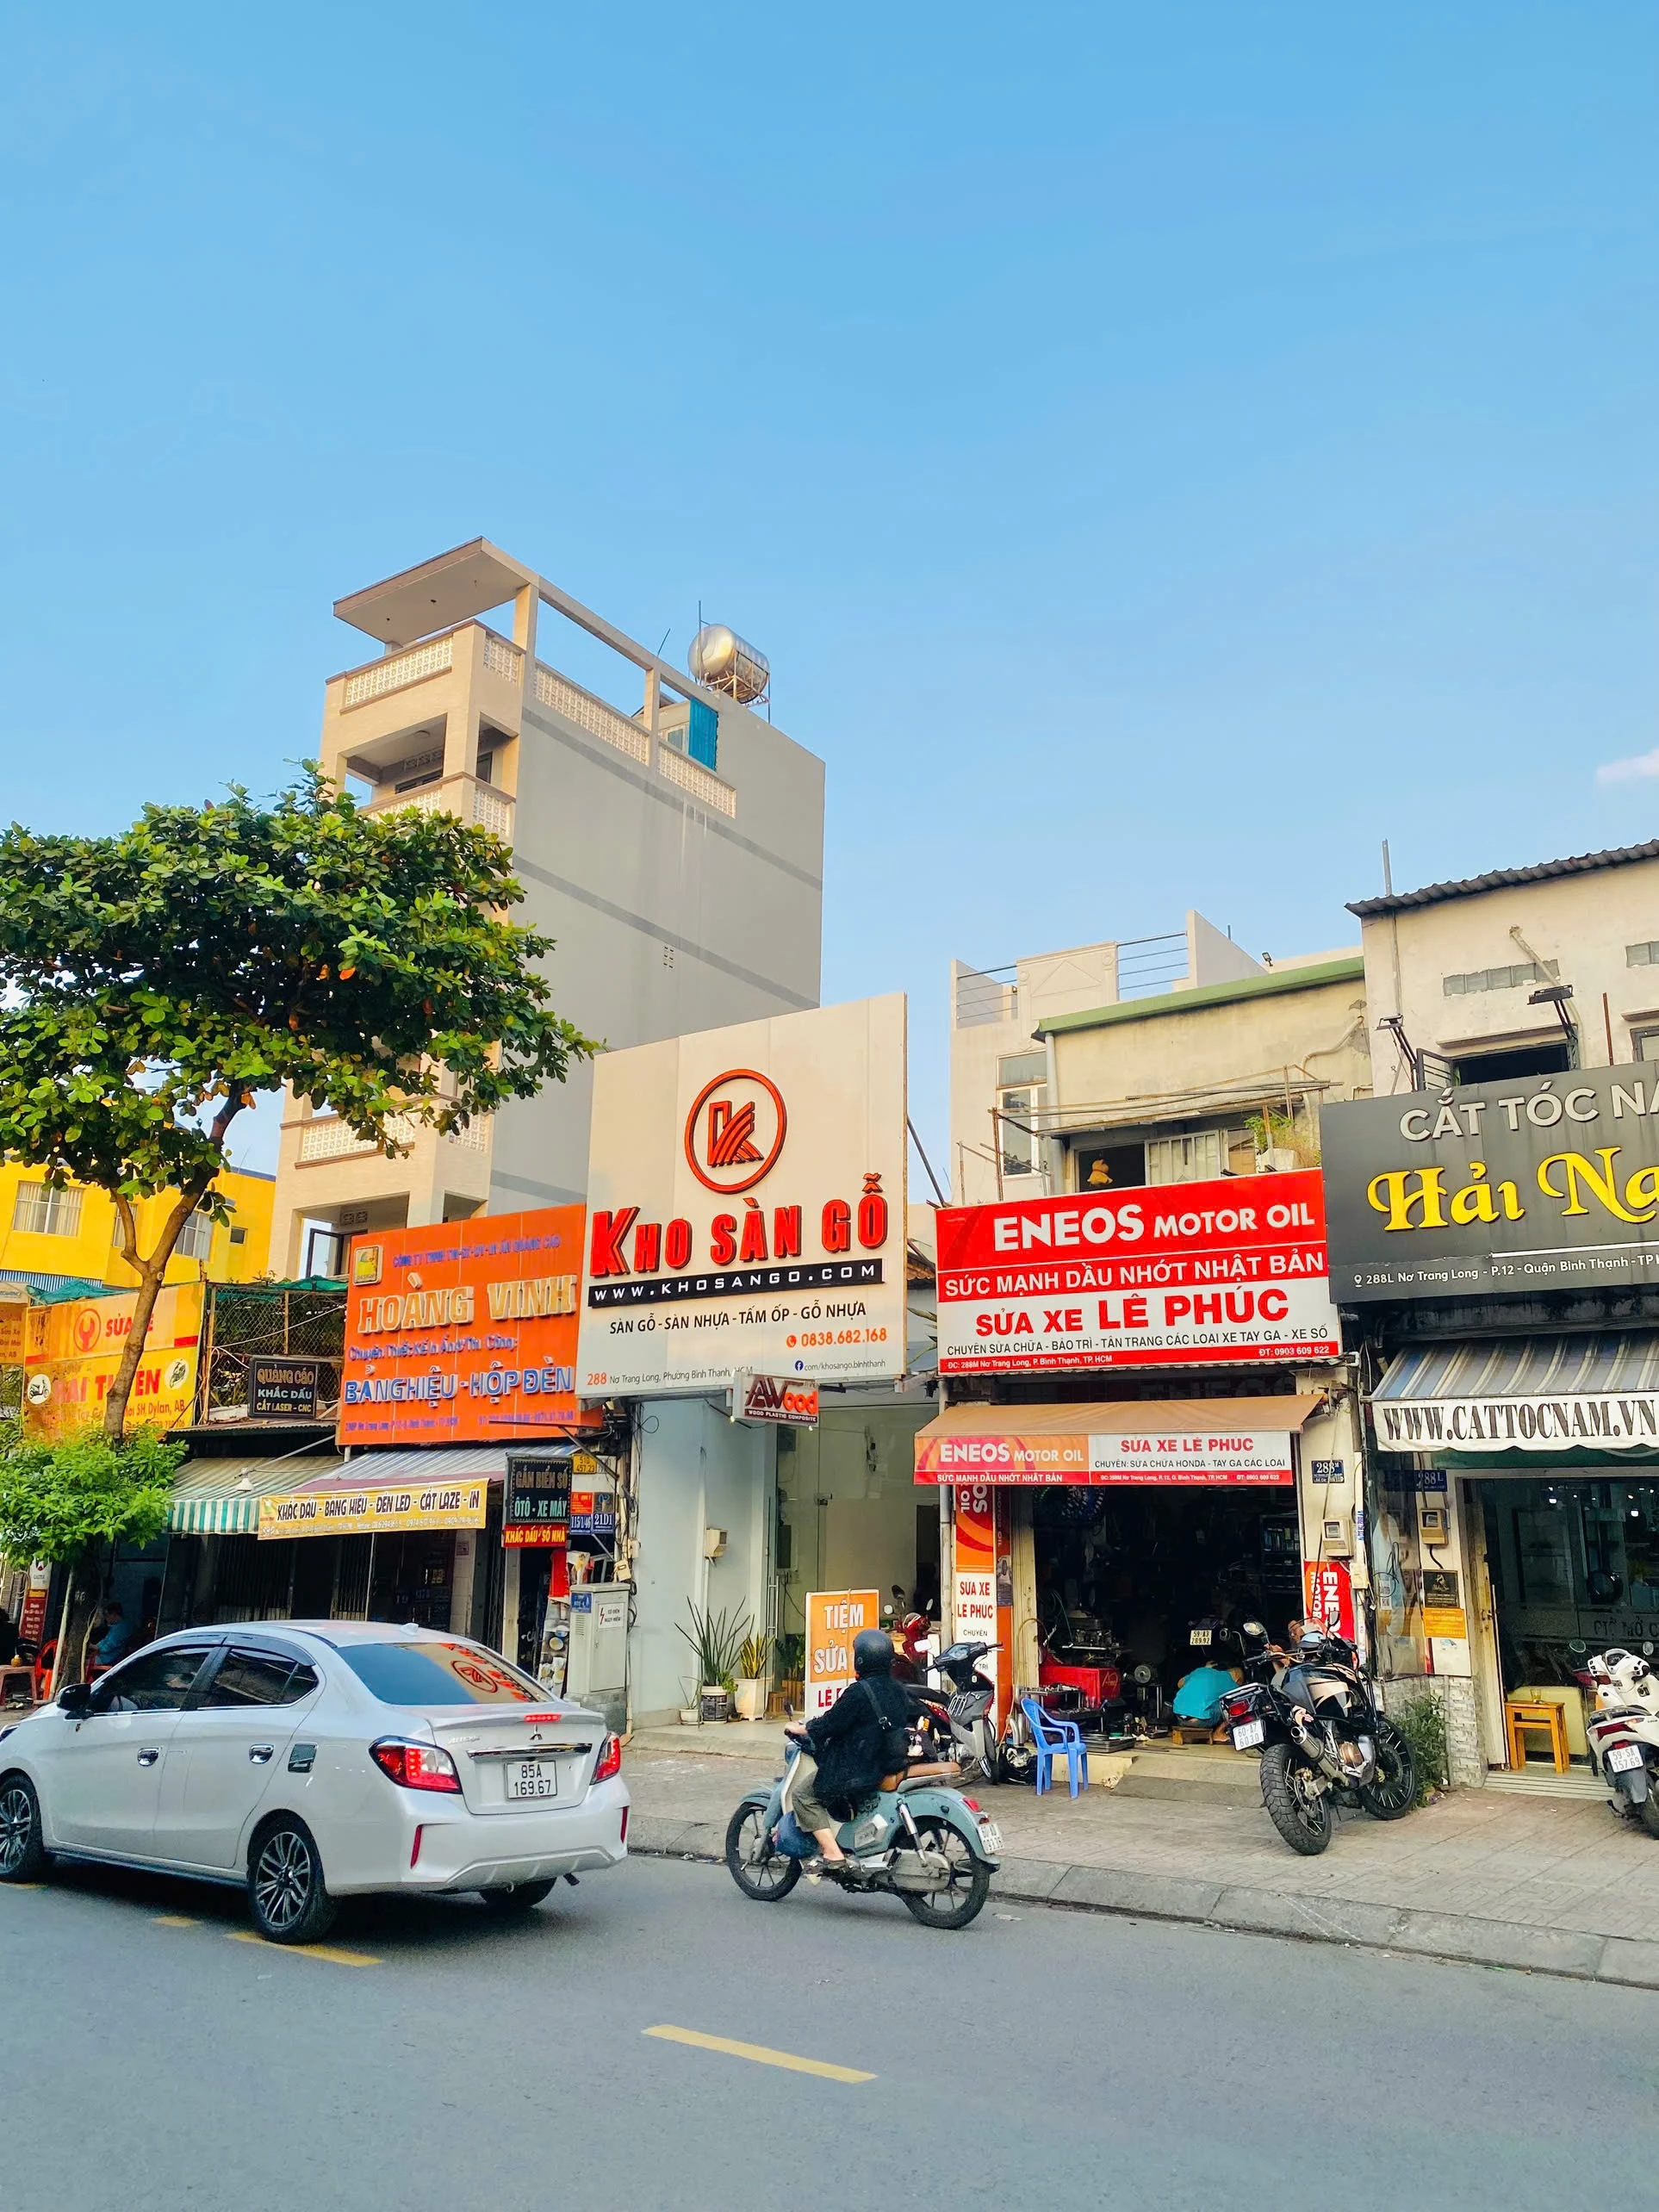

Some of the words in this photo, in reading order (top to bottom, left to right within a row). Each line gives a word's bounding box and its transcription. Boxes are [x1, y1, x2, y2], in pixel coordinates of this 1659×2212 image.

[1400, 1087, 1485, 1141] CẮT
[1499, 1081, 1600, 1130] TÓC
[1367, 1160, 1525, 1232] Hải
[711, 1197, 802, 1266] SÀN
[821, 1172, 888, 1252] GỖ
[994, 1204, 1145, 1252] ENEOS
[1153, 1208, 1258, 1238] MOTOR
[1267, 1202, 1315, 1228] OIL
[945, 1275, 991, 1296] SỨC
[997, 1271, 1059, 1296] MẠNH
[1066, 1263, 1112, 1288] DẦU
[1120, 1258, 1187, 1283] NHỚT
[1195, 1254, 1261, 1282] NHẬT
[1269, 1248, 1324, 1274] BẢN
[1366, 1274, 1394, 1285] 288L
[1398, 1271, 1414, 1283] Nơ
[1417, 1271, 1448, 1283] Trang
[1451, 1269, 1479, 1281] Long
[1491, 1265, 1514, 1276] P.12
[1524, 1262, 1556, 1277] Quận
[1560, 1258, 1586, 1271] Bình
[1589, 1258, 1629, 1272] Thạnh
[357, 1271, 474, 1333] HOÀNG
[487, 1275, 577, 1320] VINH
[976, 1308, 1034, 1337] SỬA
[1043, 1308, 1083, 1333] XE
[1098, 1293, 1149, 1330] LÊ
[1165, 1285, 1289, 1327] PHÚC
[610, 1318, 633, 1334] SÀN
[637, 1312, 656, 1332] GỖ
[664, 1314, 689, 1331] SÀN
[693, 1311, 730, 1330] NHỰA
[739, 1305, 767, 1324] TẤM
[771, 1303, 790, 1321] ỐP
[801, 1301, 821, 1320] GỖ
[826, 1302, 867, 1321] NHỰA
[801, 1328, 887, 1347] 0838.682.168
[948, 1342, 986, 1356] CHUYÊN
[1013, 1339, 1043, 1352] CHỮA
[1052, 1339, 1073, 1351] BẢO
[1076, 1337, 1092, 1350] TRÌ
[1101, 1335, 1122, 1349] TÂN
[1125, 1336, 1163, 1348] TRANG
[1165, 1333, 1190, 1345] CÁC
[1193, 1333, 1219, 1346] LOẠI
[1222, 1332, 1237, 1343] XE
[1240, 1331, 1260, 1342] TAY
[1264, 1330, 1281, 1341] GA
[1291, 1328, 1307, 1339] XE
[1310, 1323, 1328, 1339] SỐ
[1259, 1348, 1273, 1357] ĐT:
[1274, 1347, 1295, 1356] 0903
[1296, 1346, 1312, 1355] 609
[1314, 1345, 1329, 1354] 622
[991, 1359, 1010, 1369] Trang
[1012, 1358, 1032, 1368] Long,
[1040, 1356, 1055, 1364] Bình
[1057, 1356, 1081, 1365] Thạnh,
[1094, 1355, 1113, 1364] HCM
[257, 1364, 293, 1384] QUẢNG
[295, 1367, 314, 1385] CÁO
[470, 1361, 519, 1404] HỘP
[522, 1356, 575, 1394] ĐÈN
[587, 1372, 607, 1385] 288
[610, 1375, 619, 1384] Nơ
[622, 1374, 640, 1385] Trang
[643, 1373, 662, 1384] Long,
[663, 1370, 689, 1383] Phường
[692, 1369, 706, 1380] Bình
[258, 1386, 289, 1398] KHẮC
[290, 1387, 312, 1399] DẤU
[148, 1401, 172, 1420] Dylan,
[175, 1399, 185, 1412] AB
[257, 1398, 271, 1411] CẮT
[272, 1403, 292, 1412] LASER
[1382, 1400, 1657, 1440] WWW.CATTOCNAM.VN
[940, 1443, 1010, 1463] ENEOS
[1014, 1450, 1059, 1462] MOTOR
[1063, 1450, 1084, 1462] OIL
[1121, 1438, 1152, 1452] SỬA
[1157, 1439, 1177, 1451] XE
[1183, 1437, 1202, 1451] LÊ
[1209, 1436, 1254, 1451] PHÚC
[1176, 1459, 1206, 1468] HONDA
[1213, 1459, 1228, 1468] TAY
[1244, 1457, 1264, 1467] CÁC
[516, 1465, 534, 1488] GẮN
[535, 1465, 556, 1488] BIỂN
[557, 1466, 569, 1488] SỐ
[937, 1473, 954, 1482] SỨC
[956, 1474, 979, 1483] MẠNH
[980, 1472, 997, 1482] DẦU
[998, 1473, 1020, 1482] NHỚT
[1022, 1472, 1044, 1483] NHẬT
[1045, 1472, 1063, 1482] BẢN
[276, 1497, 298, 1521] KHẮC
[299, 1496, 317, 1519] DẤU
[324, 1494, 346, 1517] BẢNG
[349, 1493, 368, 1520] HIỆU
[395, 1494, 411, 1512] LED
[419, 1487, 437, 1510] CẮT
[439, 1491, 461, 1509] LAZE
[469, 1489, 480, 1508] IN
[514, 1496, 531, 1517] ÔTÔ
[537, 1500, 548, 1517] XE
[550, 1496, 568, 1517] MÁY
[594, 1513, 612, 1525] 21D1
[505, 1525, 524, 1544] KHẮC
[524, 1525, 538, 1543] DẤU
[542, 1525, 550, 1543] SỐ
[551, 1526, 565, 1543] NHÀ
[979, 1582, 991, 1596] XE
[824, 1599, 864, 1634] TIỆM
[814, 1639, 848, 1674] SỬA
[818, 1687, 832, 1708] LÊ
[521, 1764, 542, 1779] 85A
[514, 1780, 551, 1797] 169.67
